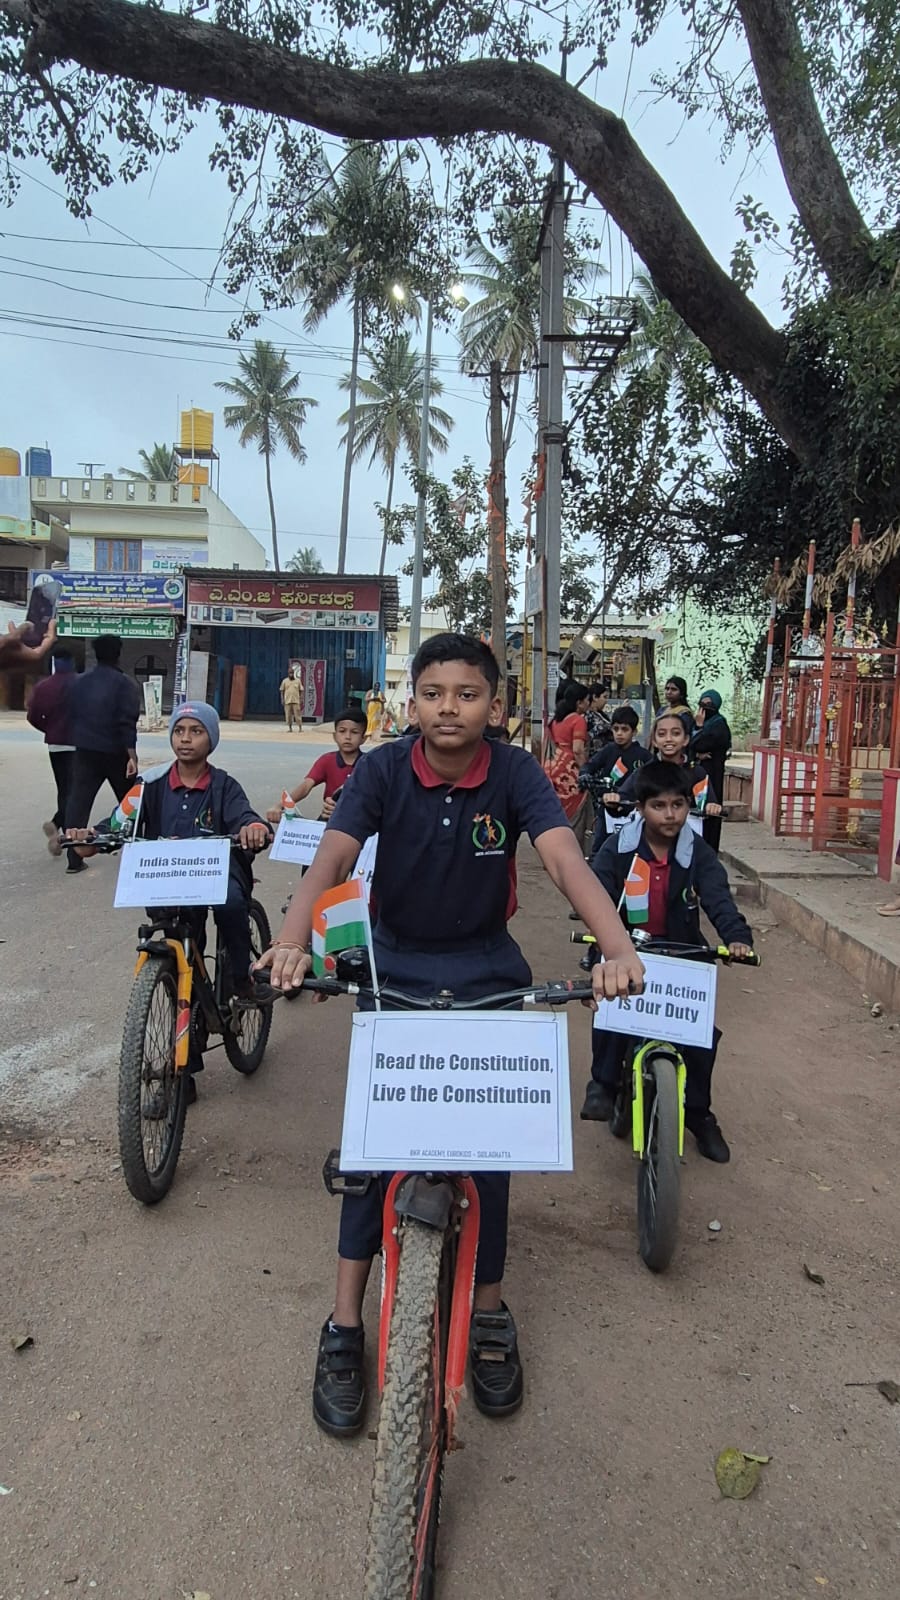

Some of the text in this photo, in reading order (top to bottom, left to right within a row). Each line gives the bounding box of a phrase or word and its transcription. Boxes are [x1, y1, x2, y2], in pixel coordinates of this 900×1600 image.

[139, 856, 220, 867] India Stands on
[134, 869, 222, 880] Responsible Citizens
[650, 981, 662, 995] in
[665, 983, 707, 1002] Action
[635, 998, 662, 1016] Our
[665, 1003, 699, 1023] Duty
[375, 1053, 554, 1073] Read the Constitution,
[372, 1084, 552, 1104] Live the Constitution
